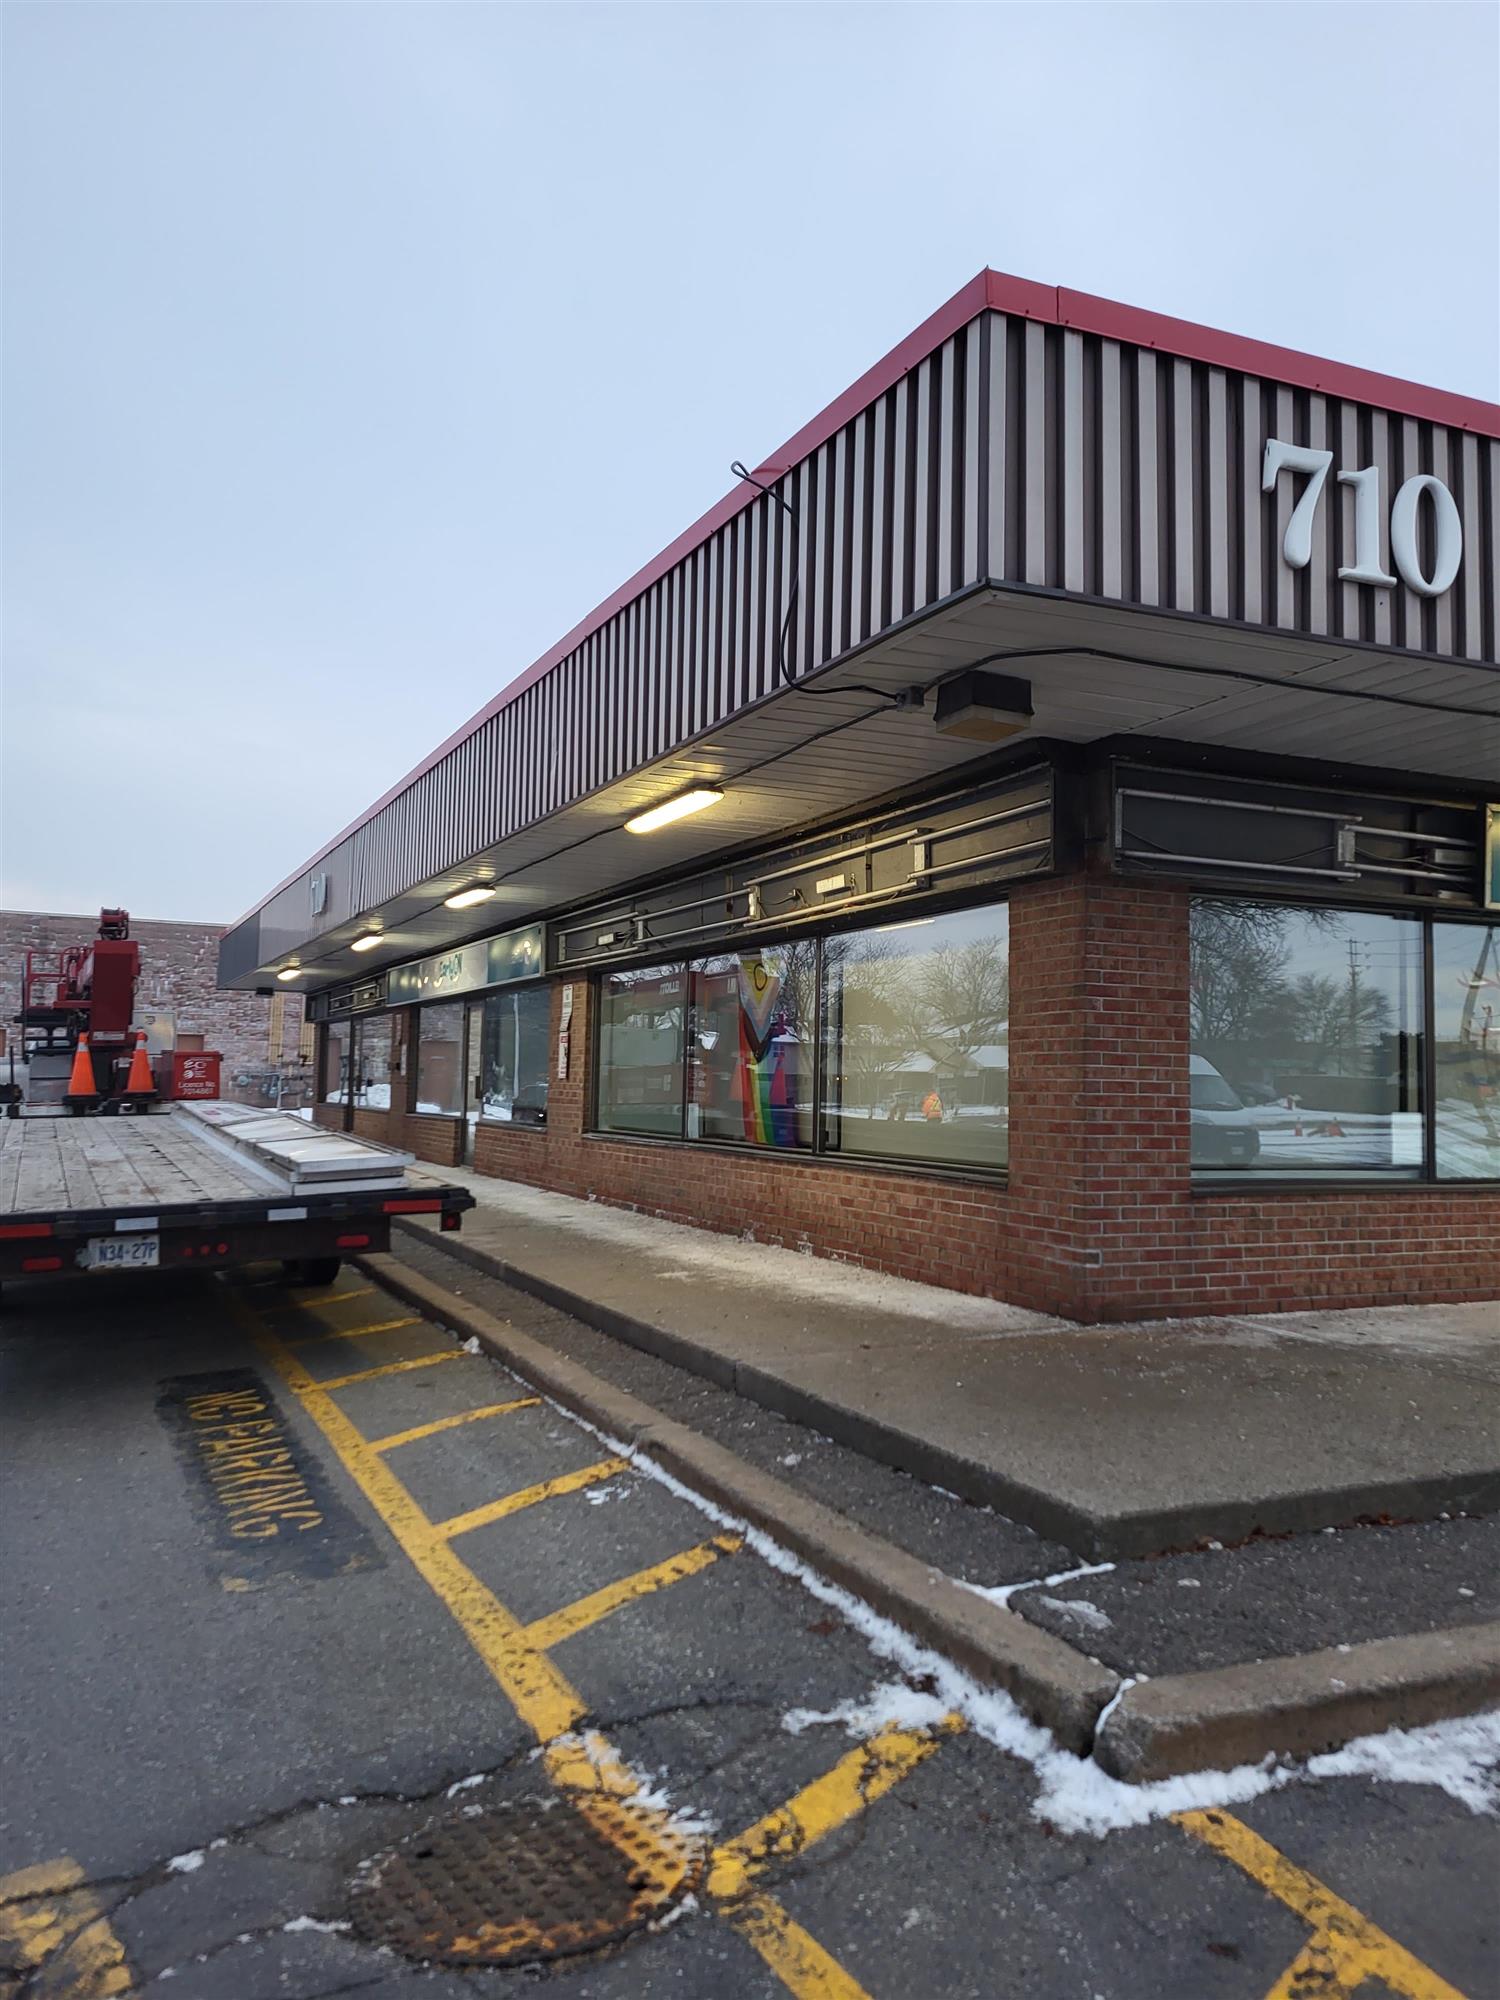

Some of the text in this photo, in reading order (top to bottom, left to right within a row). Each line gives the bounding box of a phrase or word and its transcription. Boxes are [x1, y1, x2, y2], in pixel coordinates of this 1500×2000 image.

[1262, 438, 1462, 598] 710
[184, 1387, 324, 1538] NO PARKING
